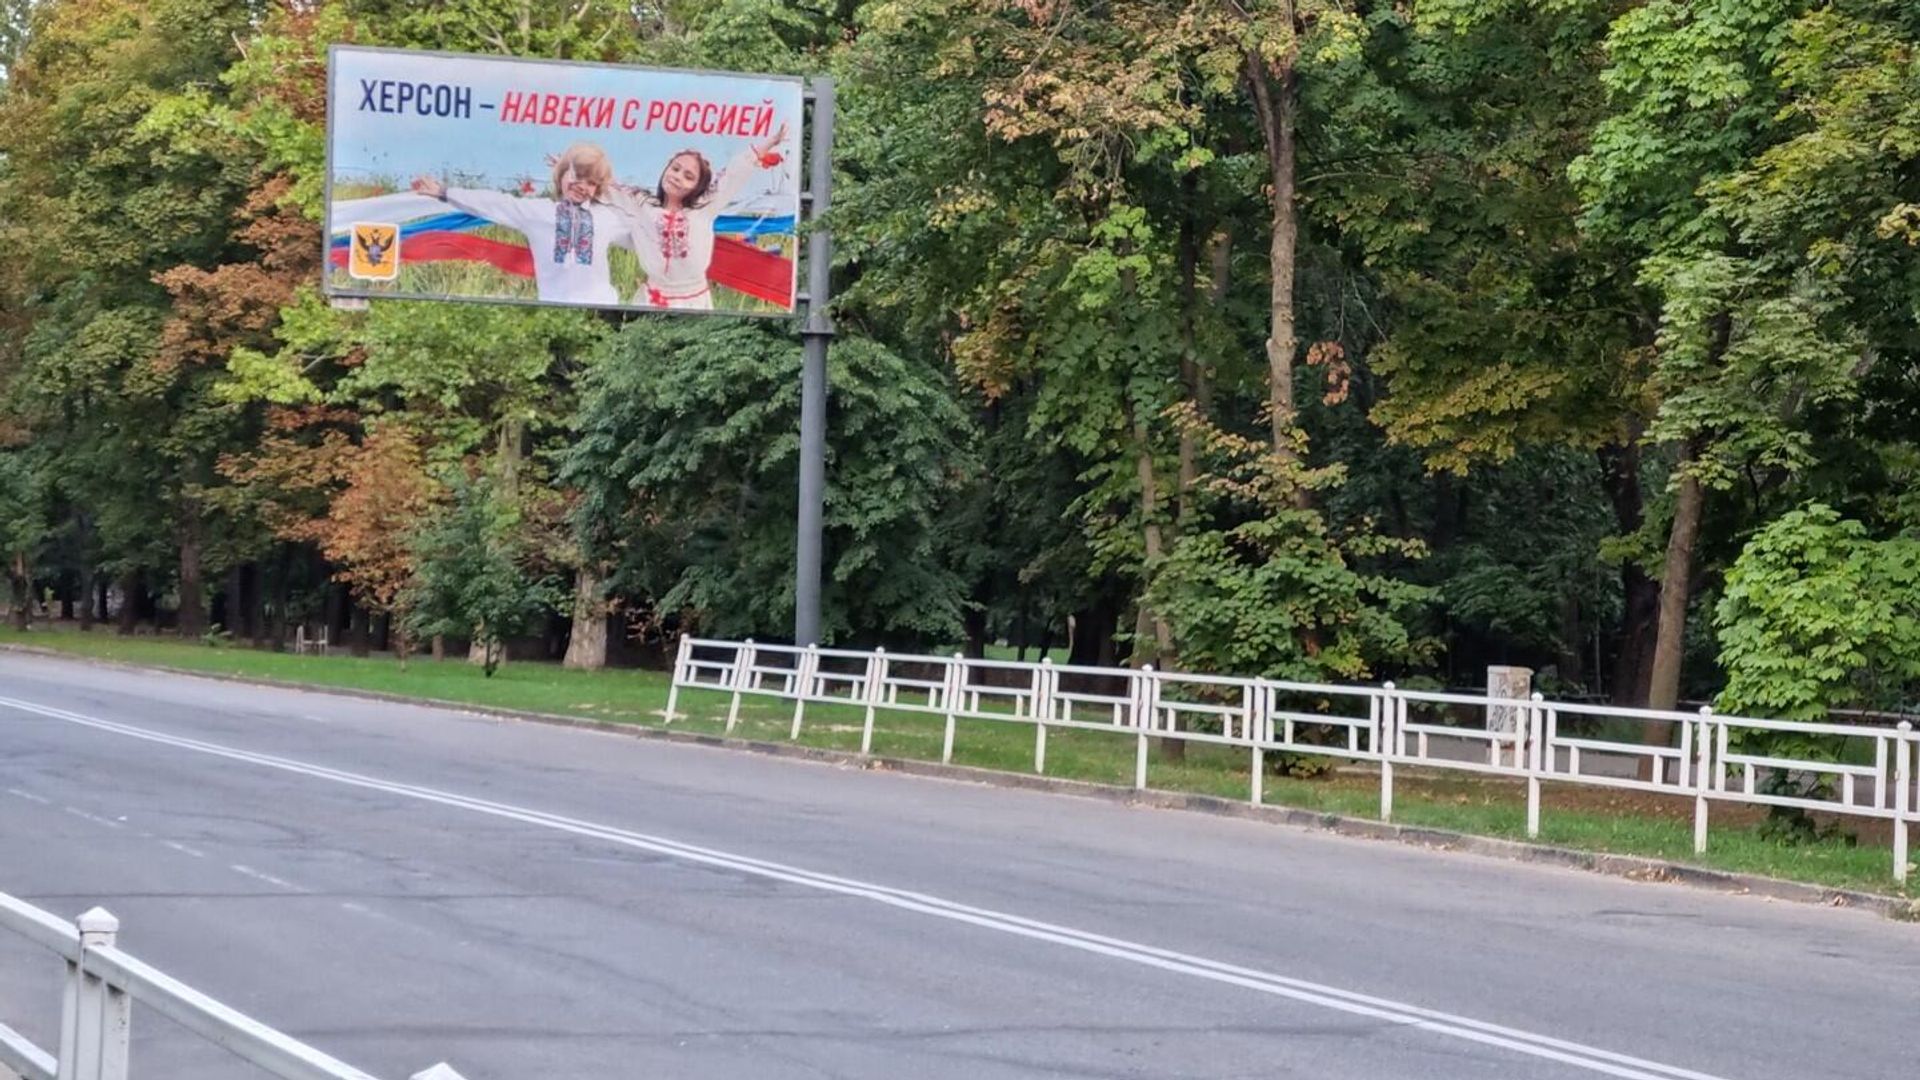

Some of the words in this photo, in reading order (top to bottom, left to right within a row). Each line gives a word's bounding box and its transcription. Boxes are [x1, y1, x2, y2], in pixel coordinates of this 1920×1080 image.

[359, 78, 471, 119] ХЕРСОН
[500, 91, 615, 129] НАВЕКИ
[622, 99, 639, 130] С
[645, 99, 774, 137] РОССИЕЙ
